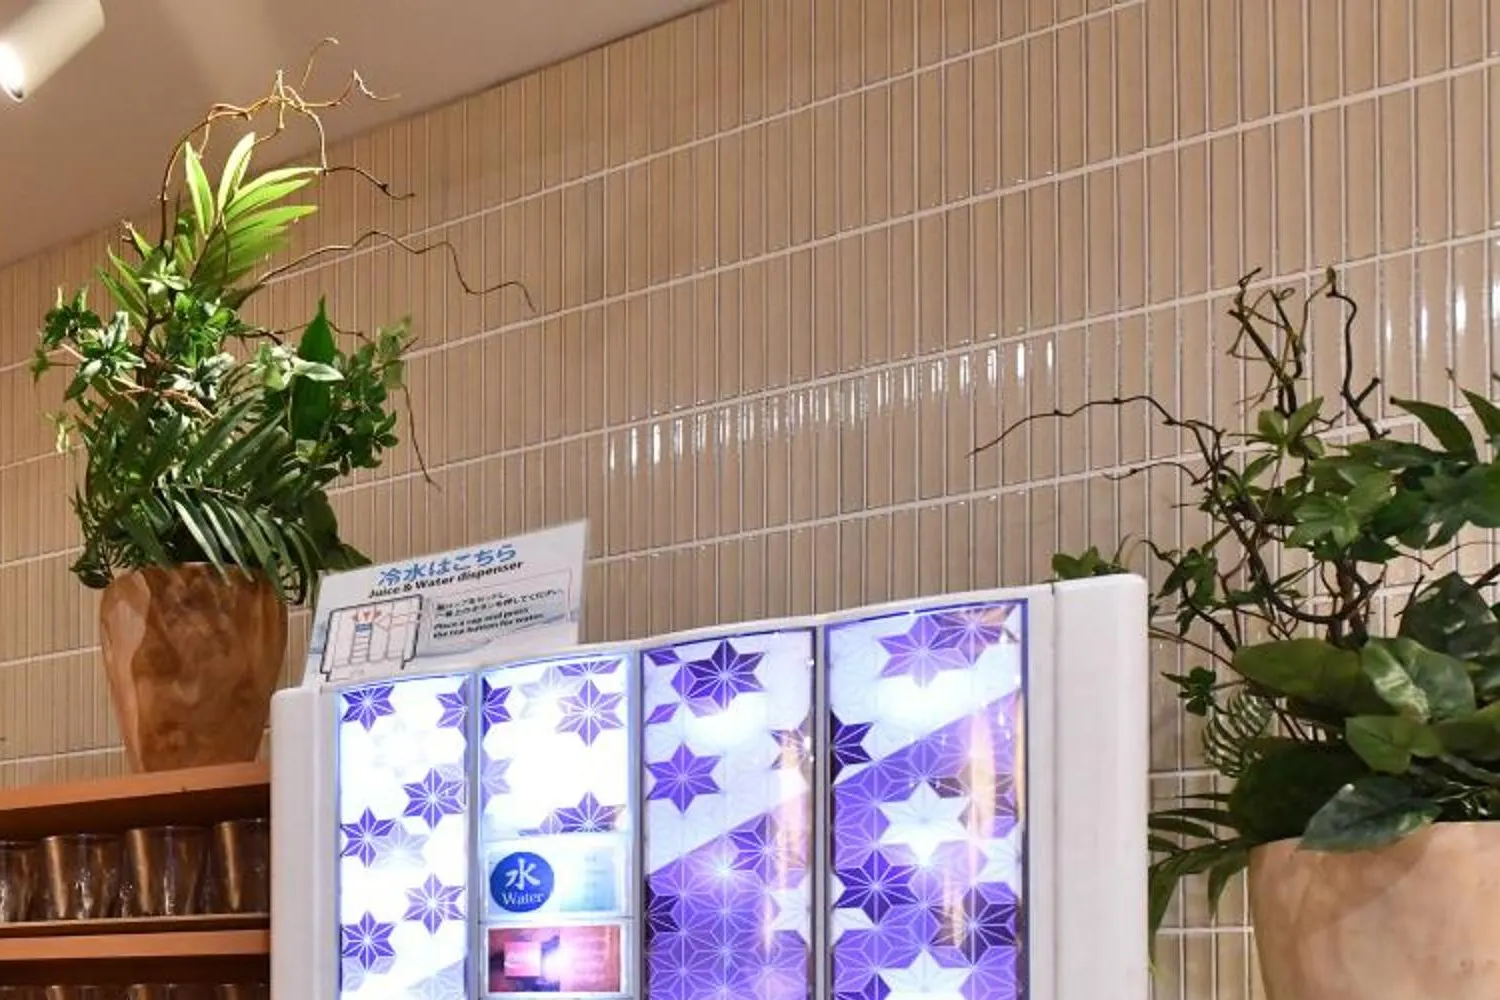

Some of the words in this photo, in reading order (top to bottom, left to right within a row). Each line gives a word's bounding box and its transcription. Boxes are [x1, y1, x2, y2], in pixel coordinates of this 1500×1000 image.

[368, 584, 401, 599] Juice
[403, 582, 413, 592] &
[415, 574, 455, 590] Water
[457, 560, 524, 582] dispenser
[380, 544, 516, 586] 冷水はこちら
[505, 856, 541, 891] 水
[501, 890, 545, 906] Water
